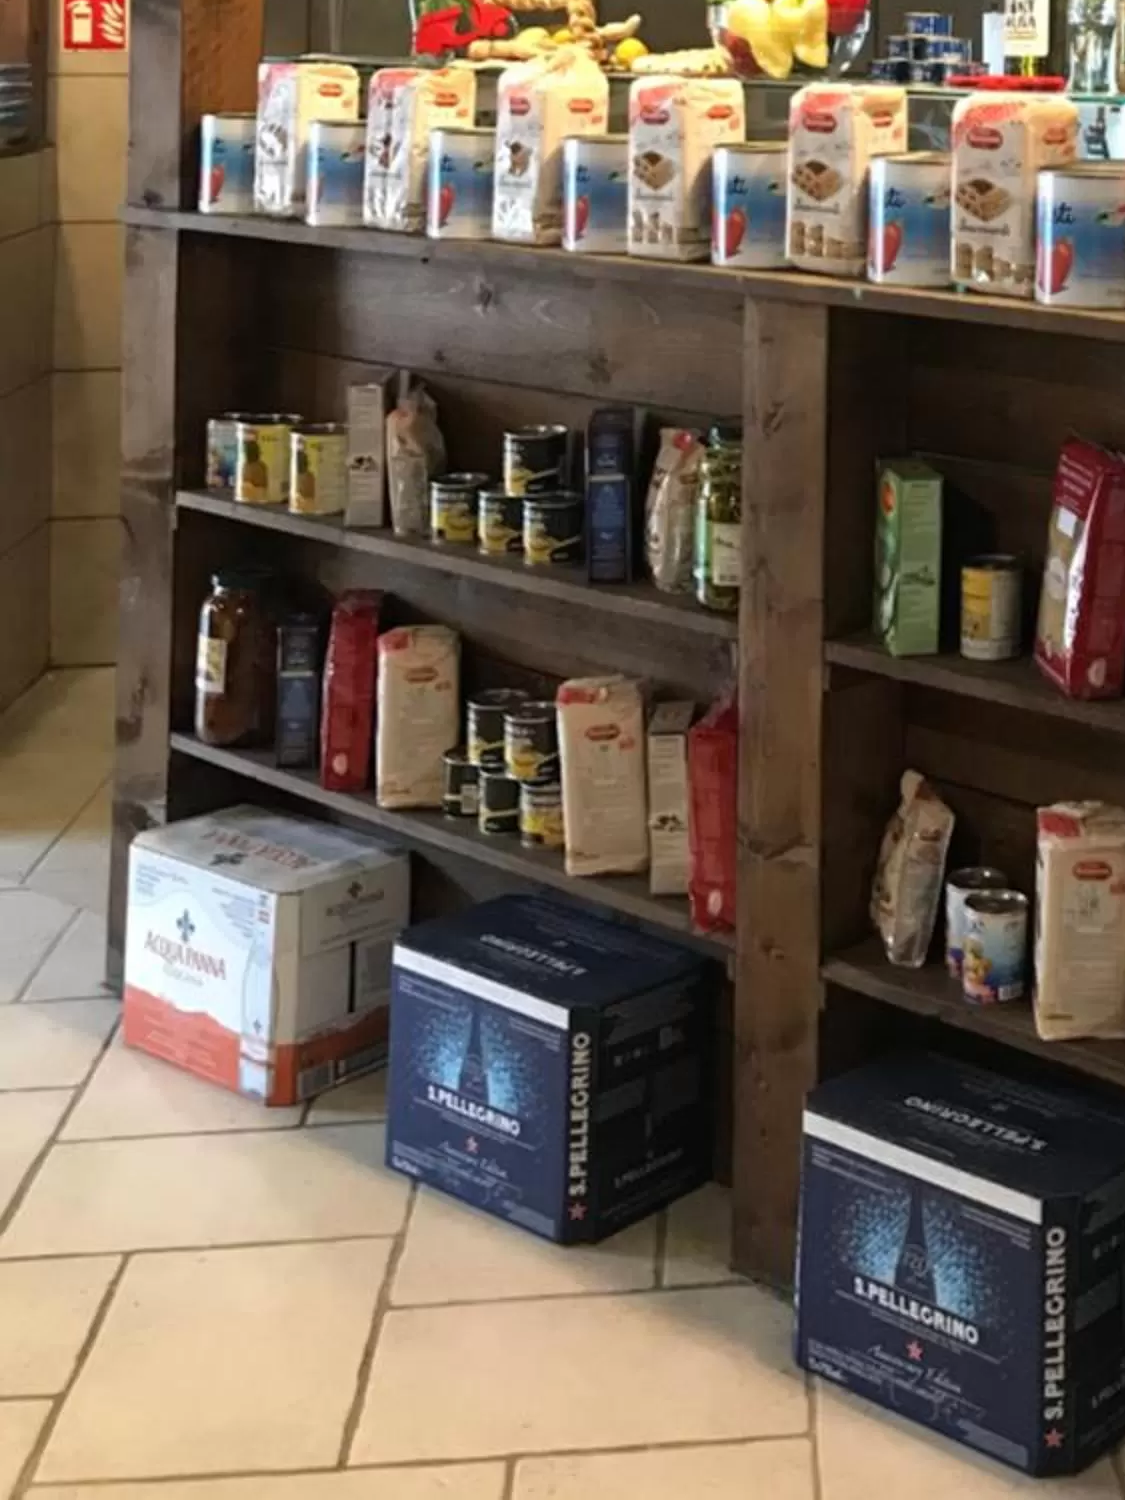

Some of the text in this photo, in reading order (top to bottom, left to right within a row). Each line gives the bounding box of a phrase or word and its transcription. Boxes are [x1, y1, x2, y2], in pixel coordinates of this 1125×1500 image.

[143, 929, 226, 981] ACQUA PANNA
[569, 1031, 591, 1196] S.PELLEGRINO
[853, 1275, 979, 1345] S.PELLEGRINO
[1043, 1224, 1068, 1422] S.PELLEGRINO
